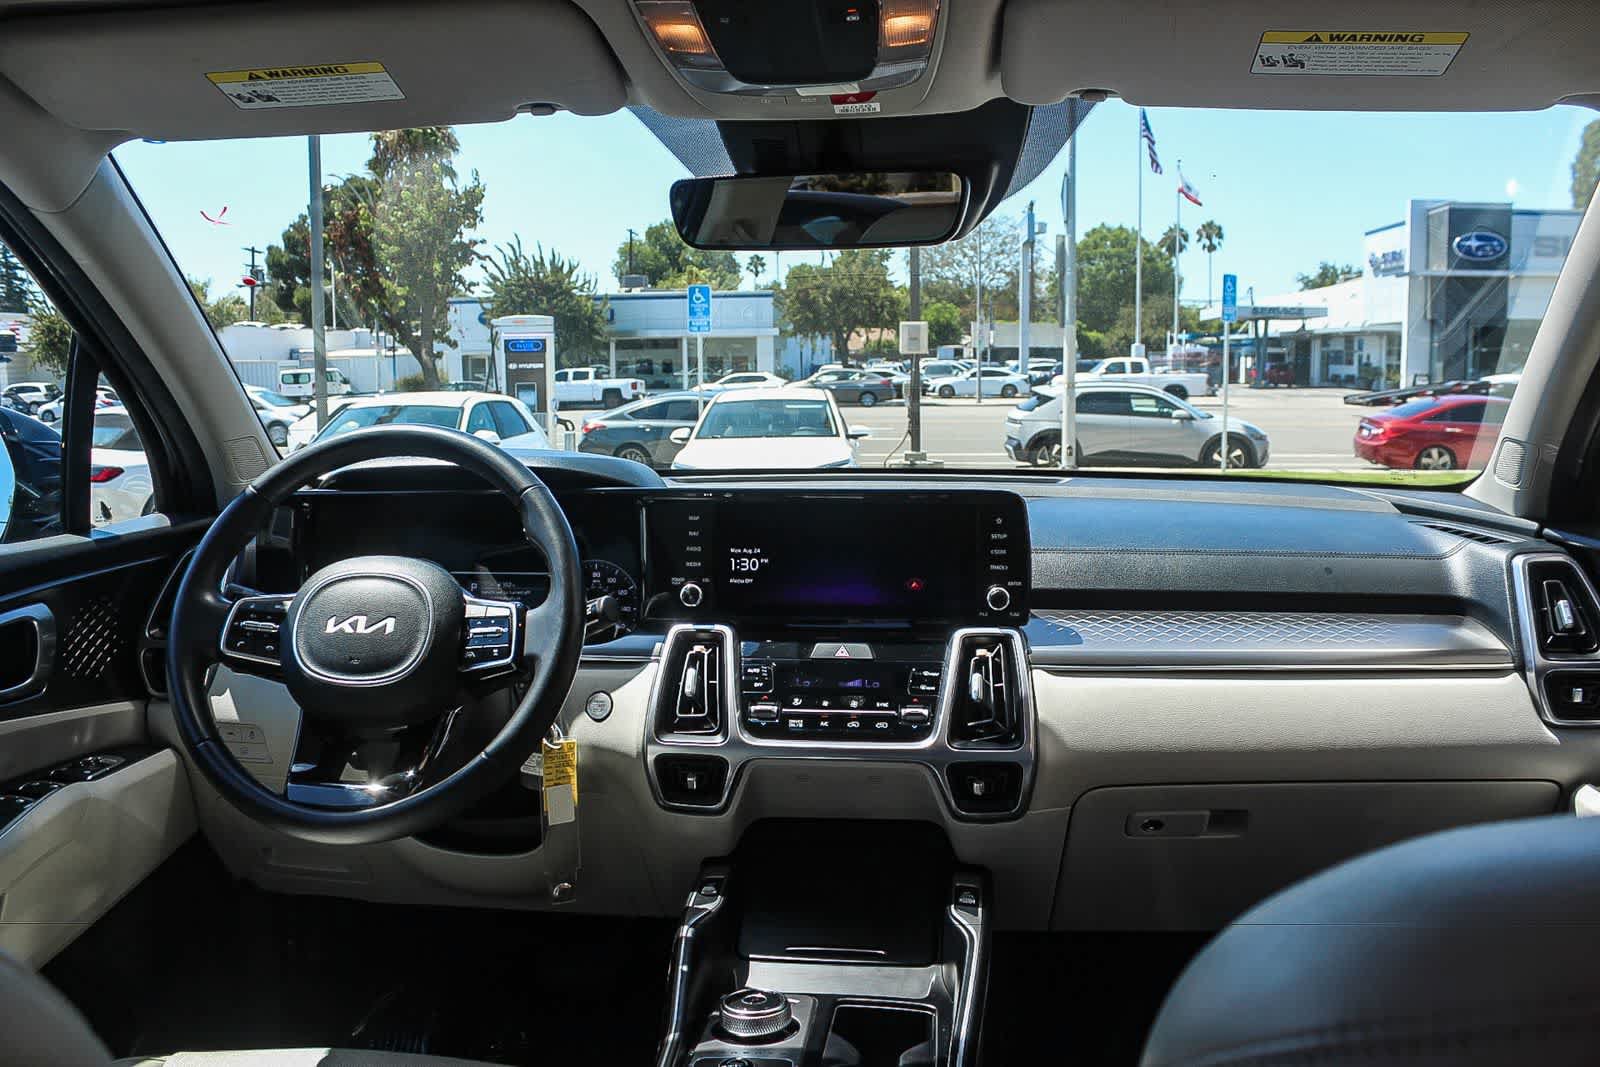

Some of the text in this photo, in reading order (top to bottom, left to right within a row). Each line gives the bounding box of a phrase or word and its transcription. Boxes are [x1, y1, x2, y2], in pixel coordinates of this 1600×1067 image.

[1328, 33, 1425, 43] WARNING
[264, 65, 348, 79] WARNING
[730, 558, 759, 571] 1:30
[470, 582, 478, 592] P
[323, 613, 397, 635] KIA
